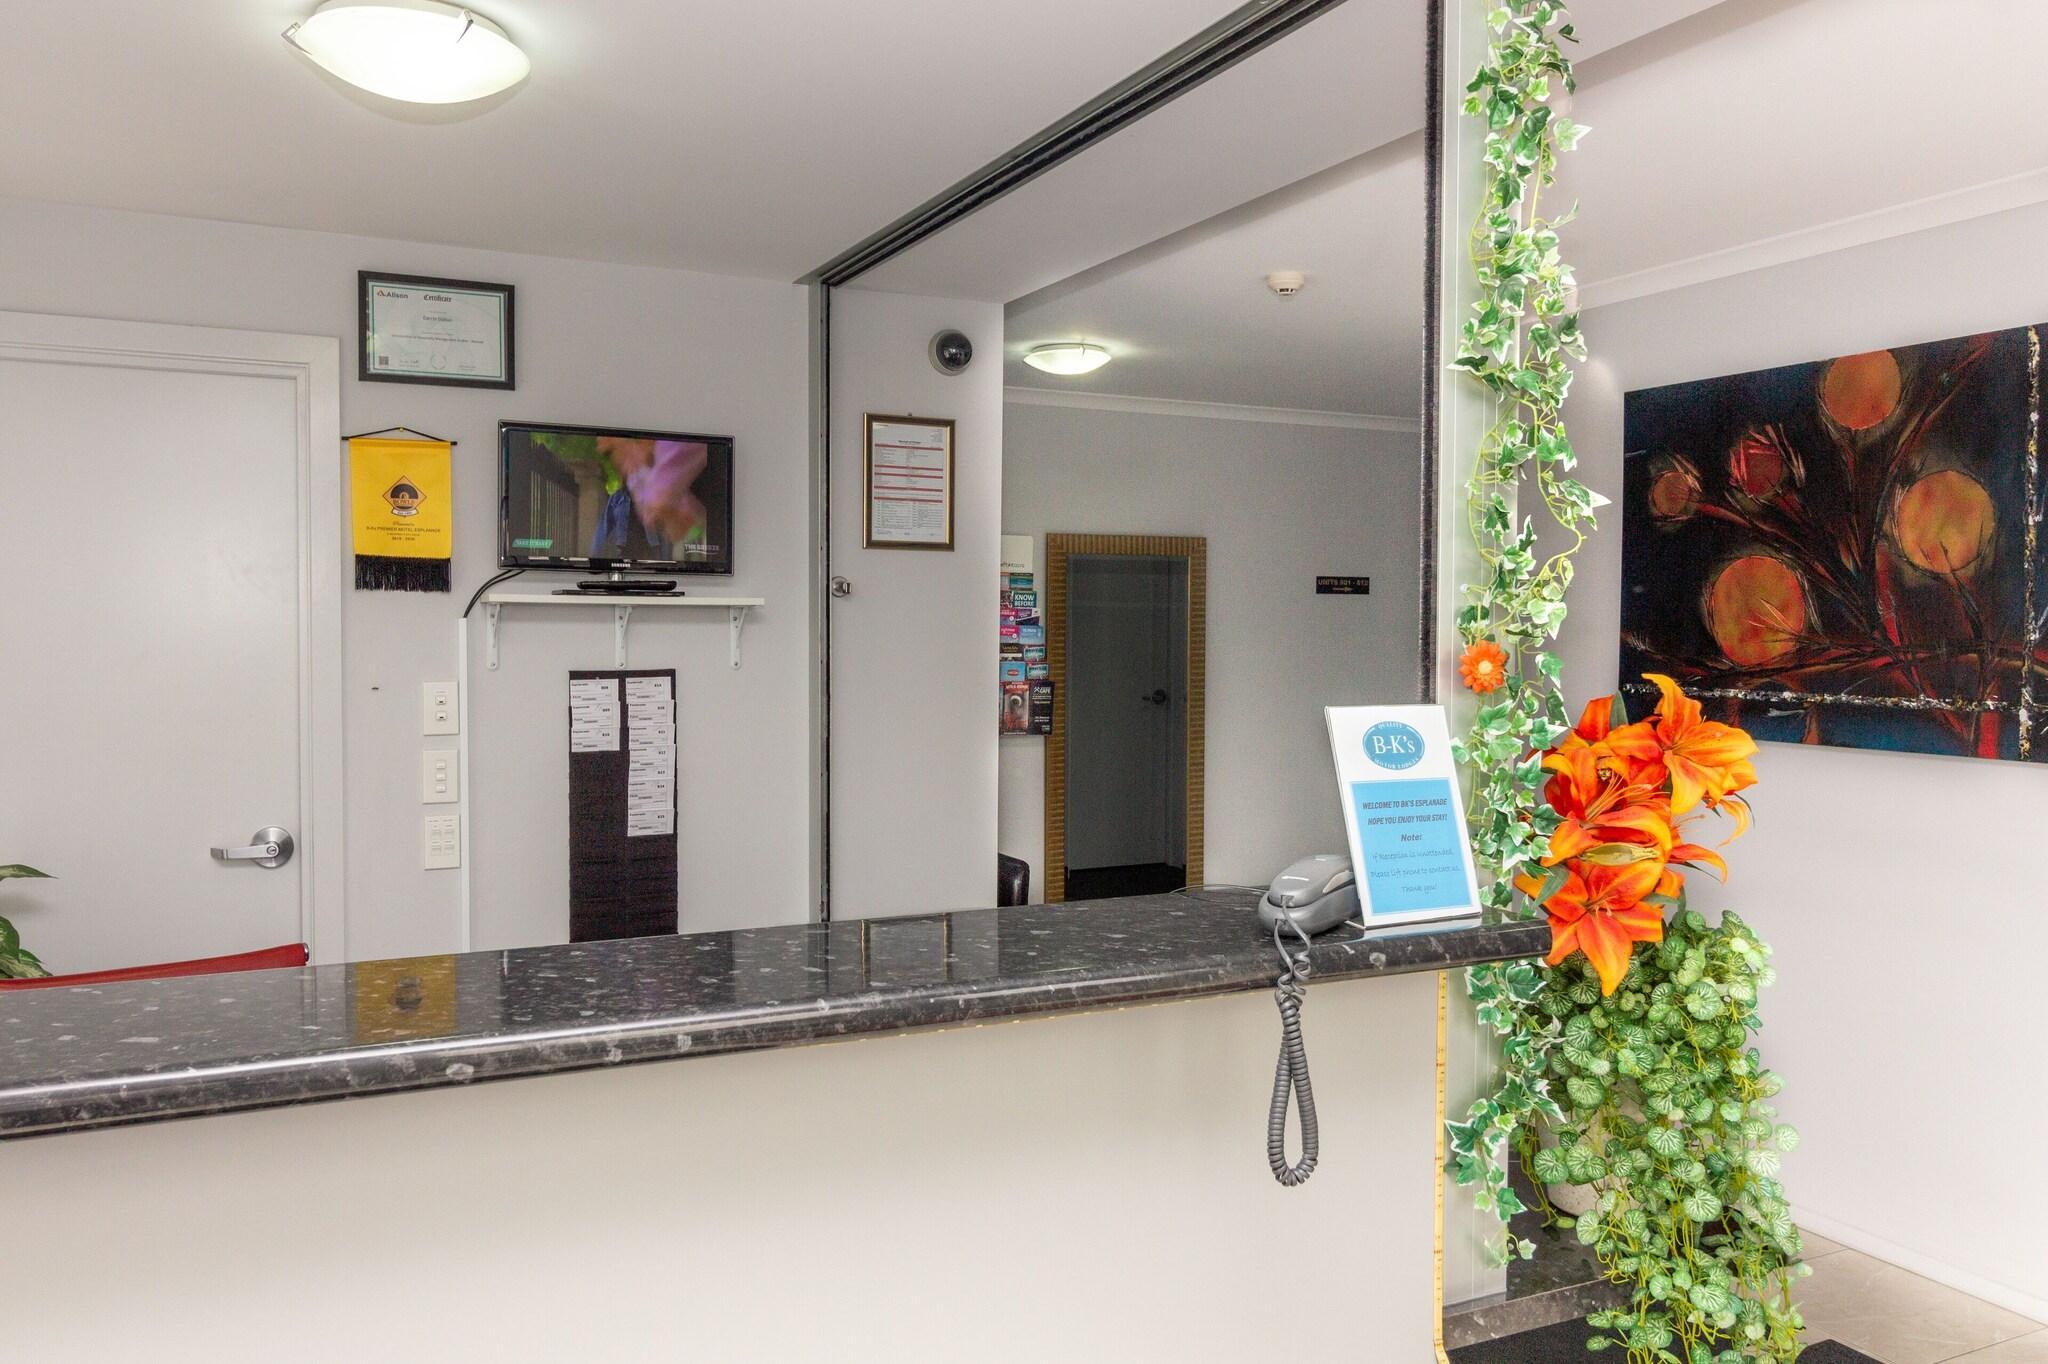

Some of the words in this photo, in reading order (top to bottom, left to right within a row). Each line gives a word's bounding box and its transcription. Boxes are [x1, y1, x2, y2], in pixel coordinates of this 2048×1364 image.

[423, 294, 453, 302] Certificate
[1372, 735, 1416, 754] B-K's
[1362, 801, 1392, 810] WELCOME
[1400, 800, 1415, 808] BK'S
[1415, 798, 1448, 807] ESPLANADE
[1368, 817, 1384, 826] HOPE
[1384, 817, 1397, 825] YOU
[1397, 816, 1415, 824] ENJOY
[1416, 815, 1431, 823] YOUR
[1431, 814, 1448, 822] STAY!
[1400, 833, 1422, 842] Note:
